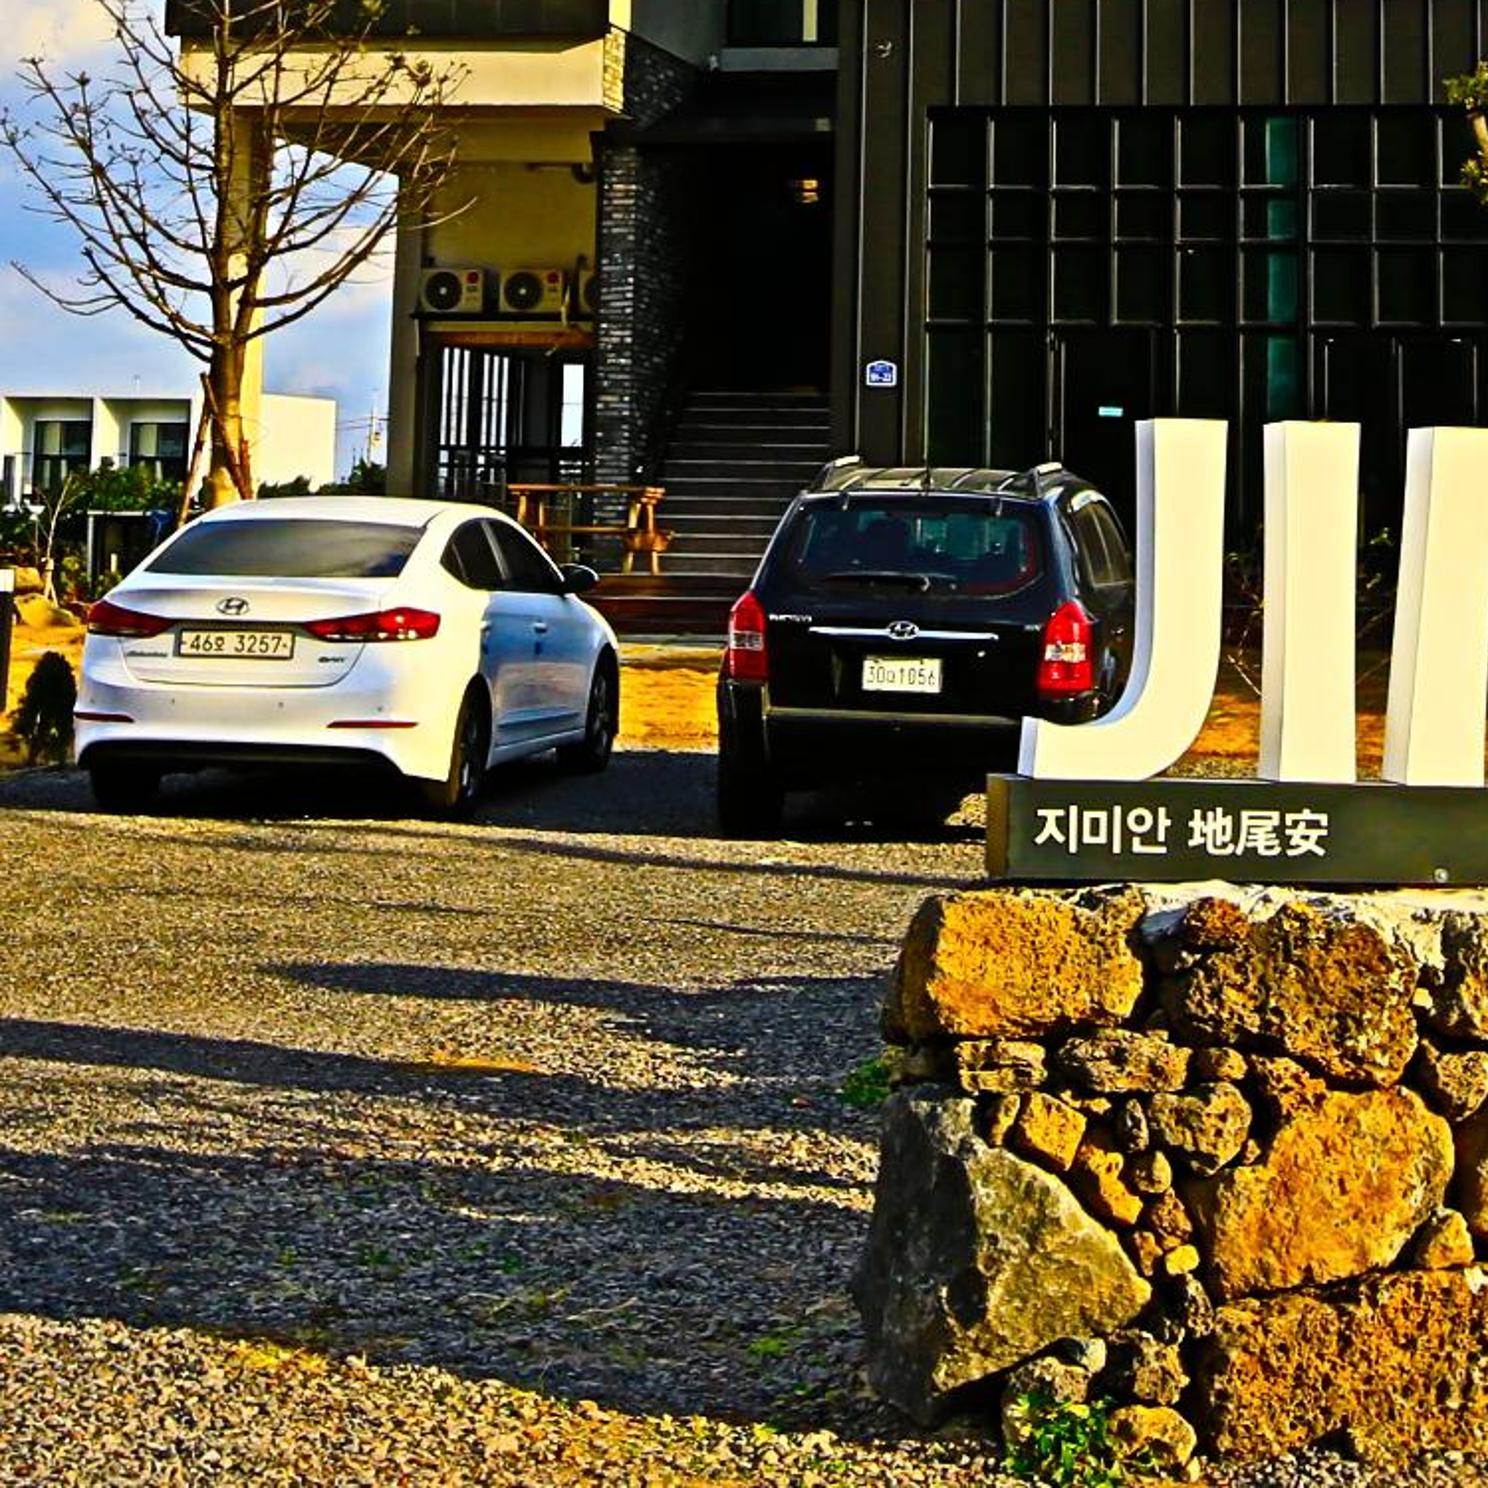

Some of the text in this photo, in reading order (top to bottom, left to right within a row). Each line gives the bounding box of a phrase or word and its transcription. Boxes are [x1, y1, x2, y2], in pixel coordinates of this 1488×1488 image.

[234, 634, 283, 654] 3257
[1033, 804, 1329, 857] 지미안 地尾安
